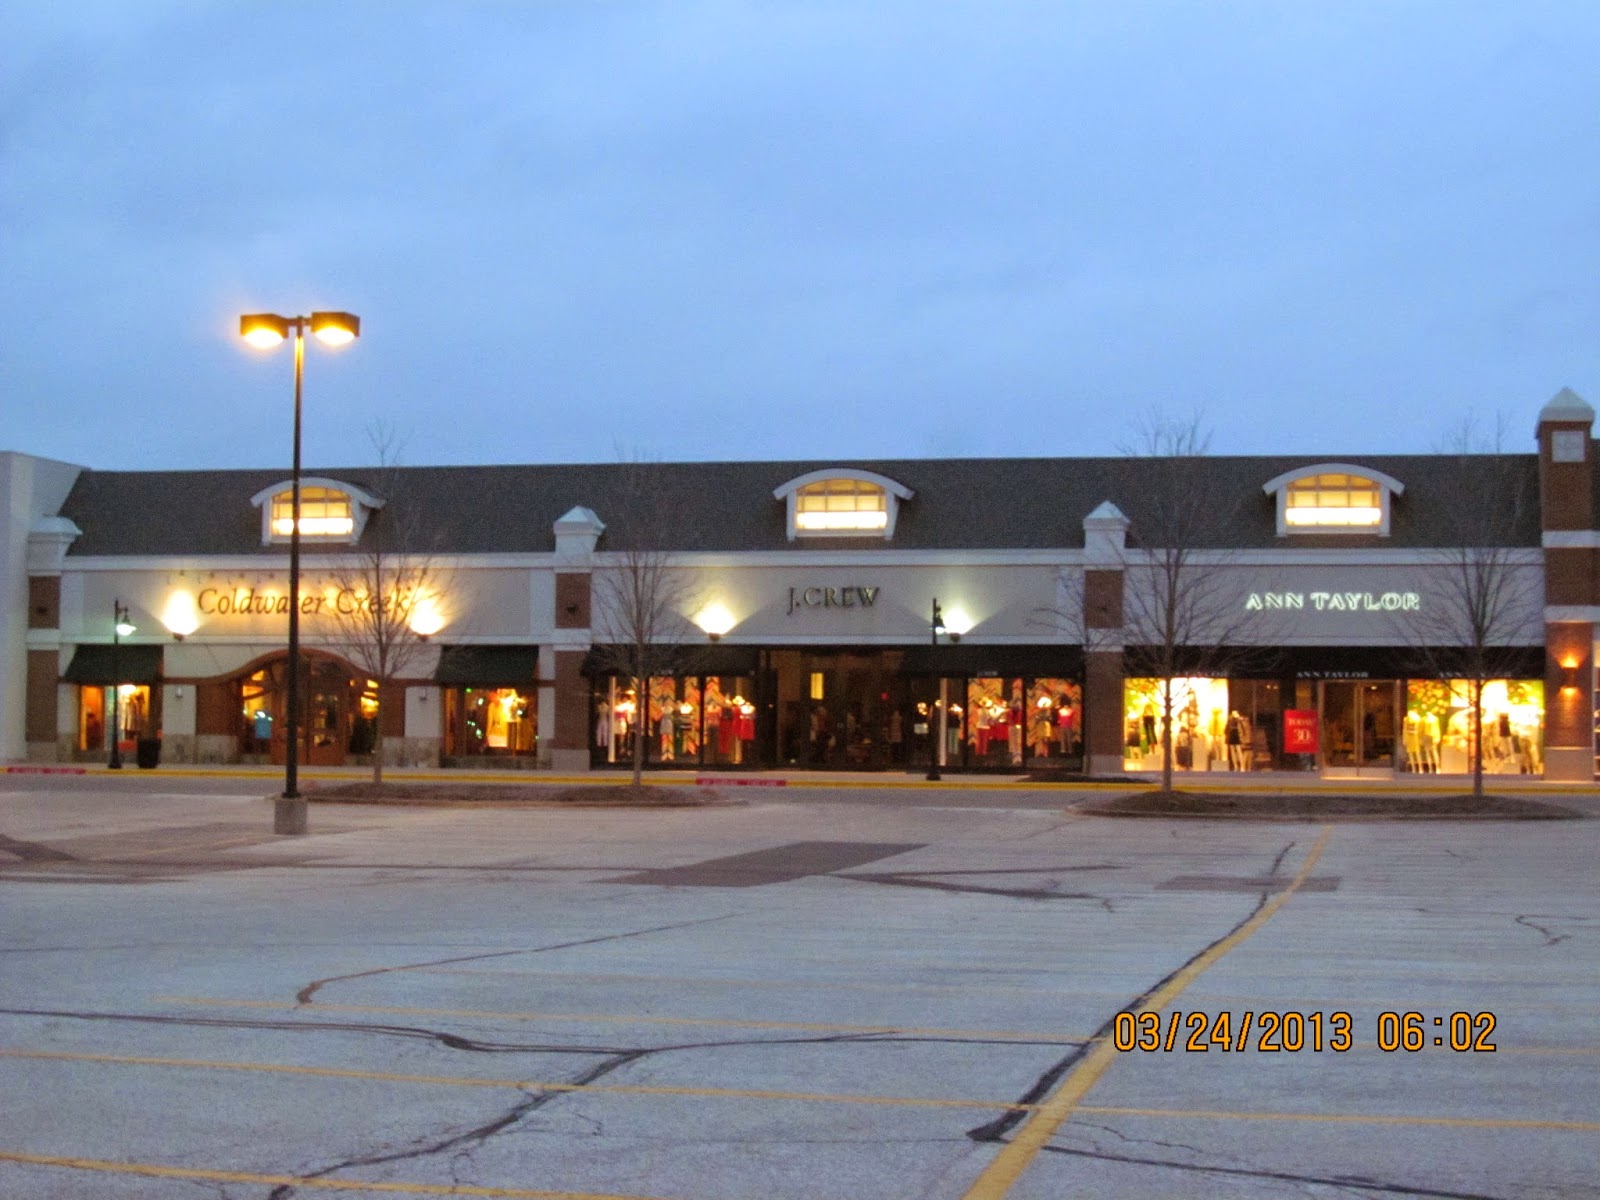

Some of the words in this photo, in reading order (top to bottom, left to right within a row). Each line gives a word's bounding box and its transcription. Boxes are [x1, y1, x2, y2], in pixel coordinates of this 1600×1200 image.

[198, 586, 327, 615] Coldwaer
[336, 587, 409, 615] Creek
[786, 586, 880, 616] J.CREW
[1245, 591, 1304, 611] ANN
[1309, 591, 1421, 611] TAYLOR
